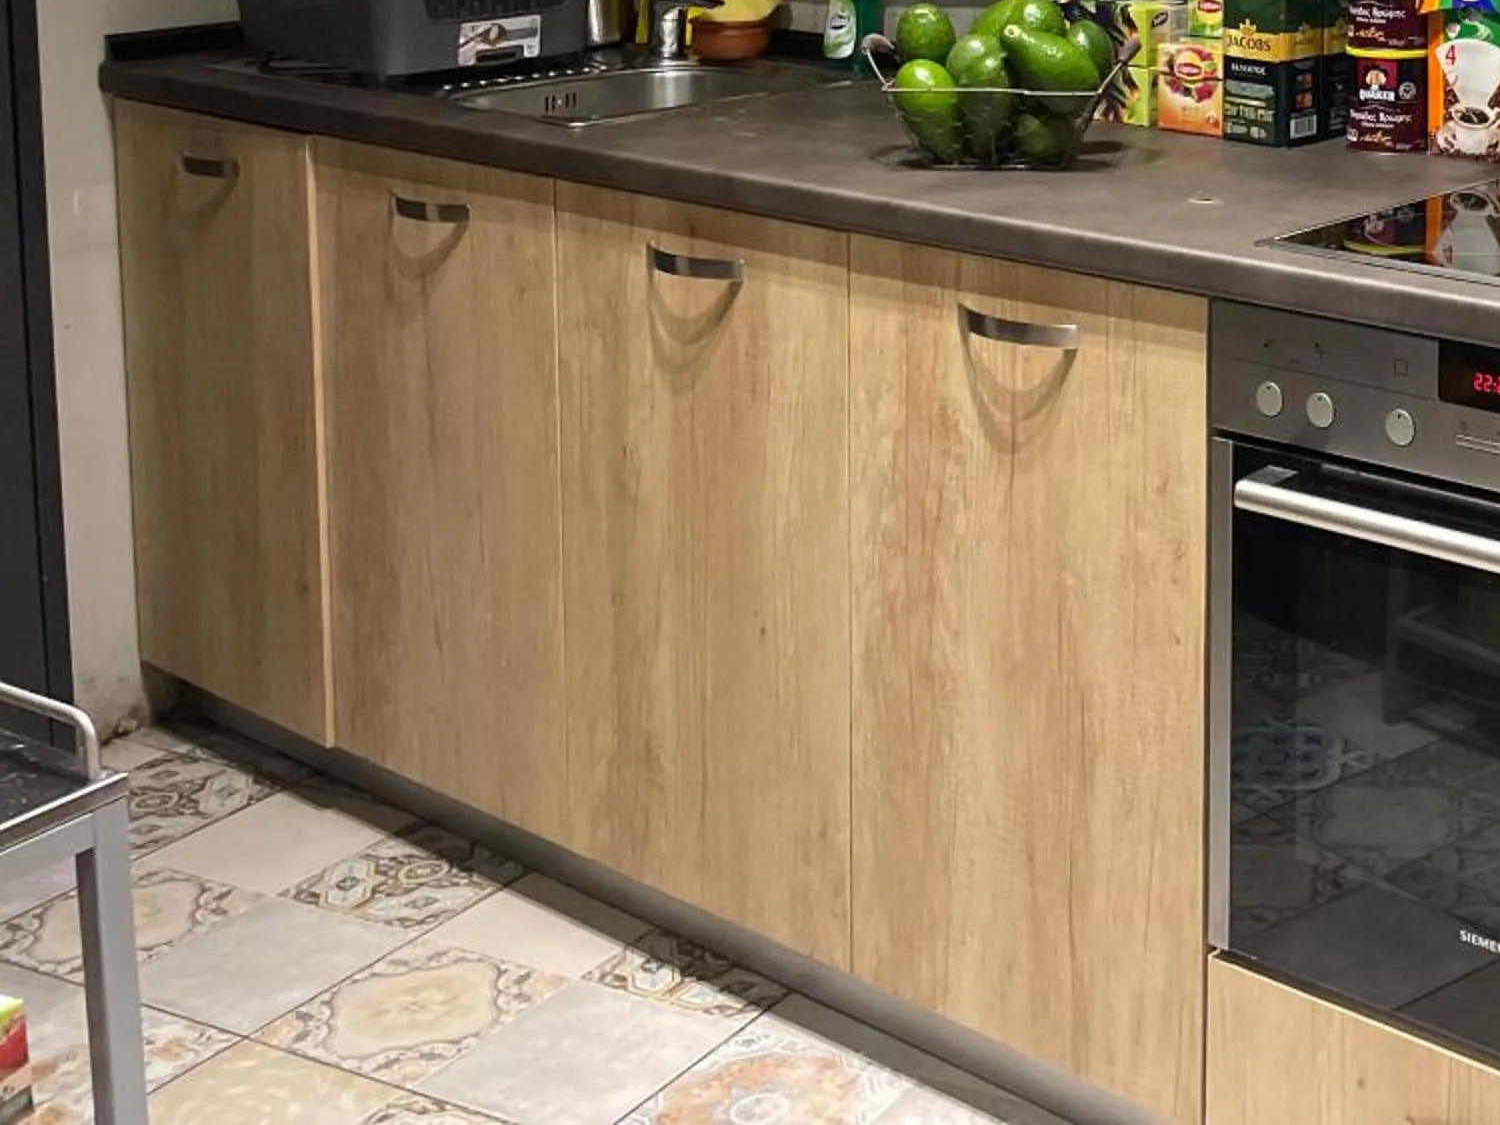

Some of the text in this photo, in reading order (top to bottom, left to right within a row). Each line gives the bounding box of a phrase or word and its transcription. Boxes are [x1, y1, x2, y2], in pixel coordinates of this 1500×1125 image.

[1225, 33, 1272, 52] JACOBS
[1445, 44, 1457, 66] 4
[1359, 88, 1396, 102] QUAKER
